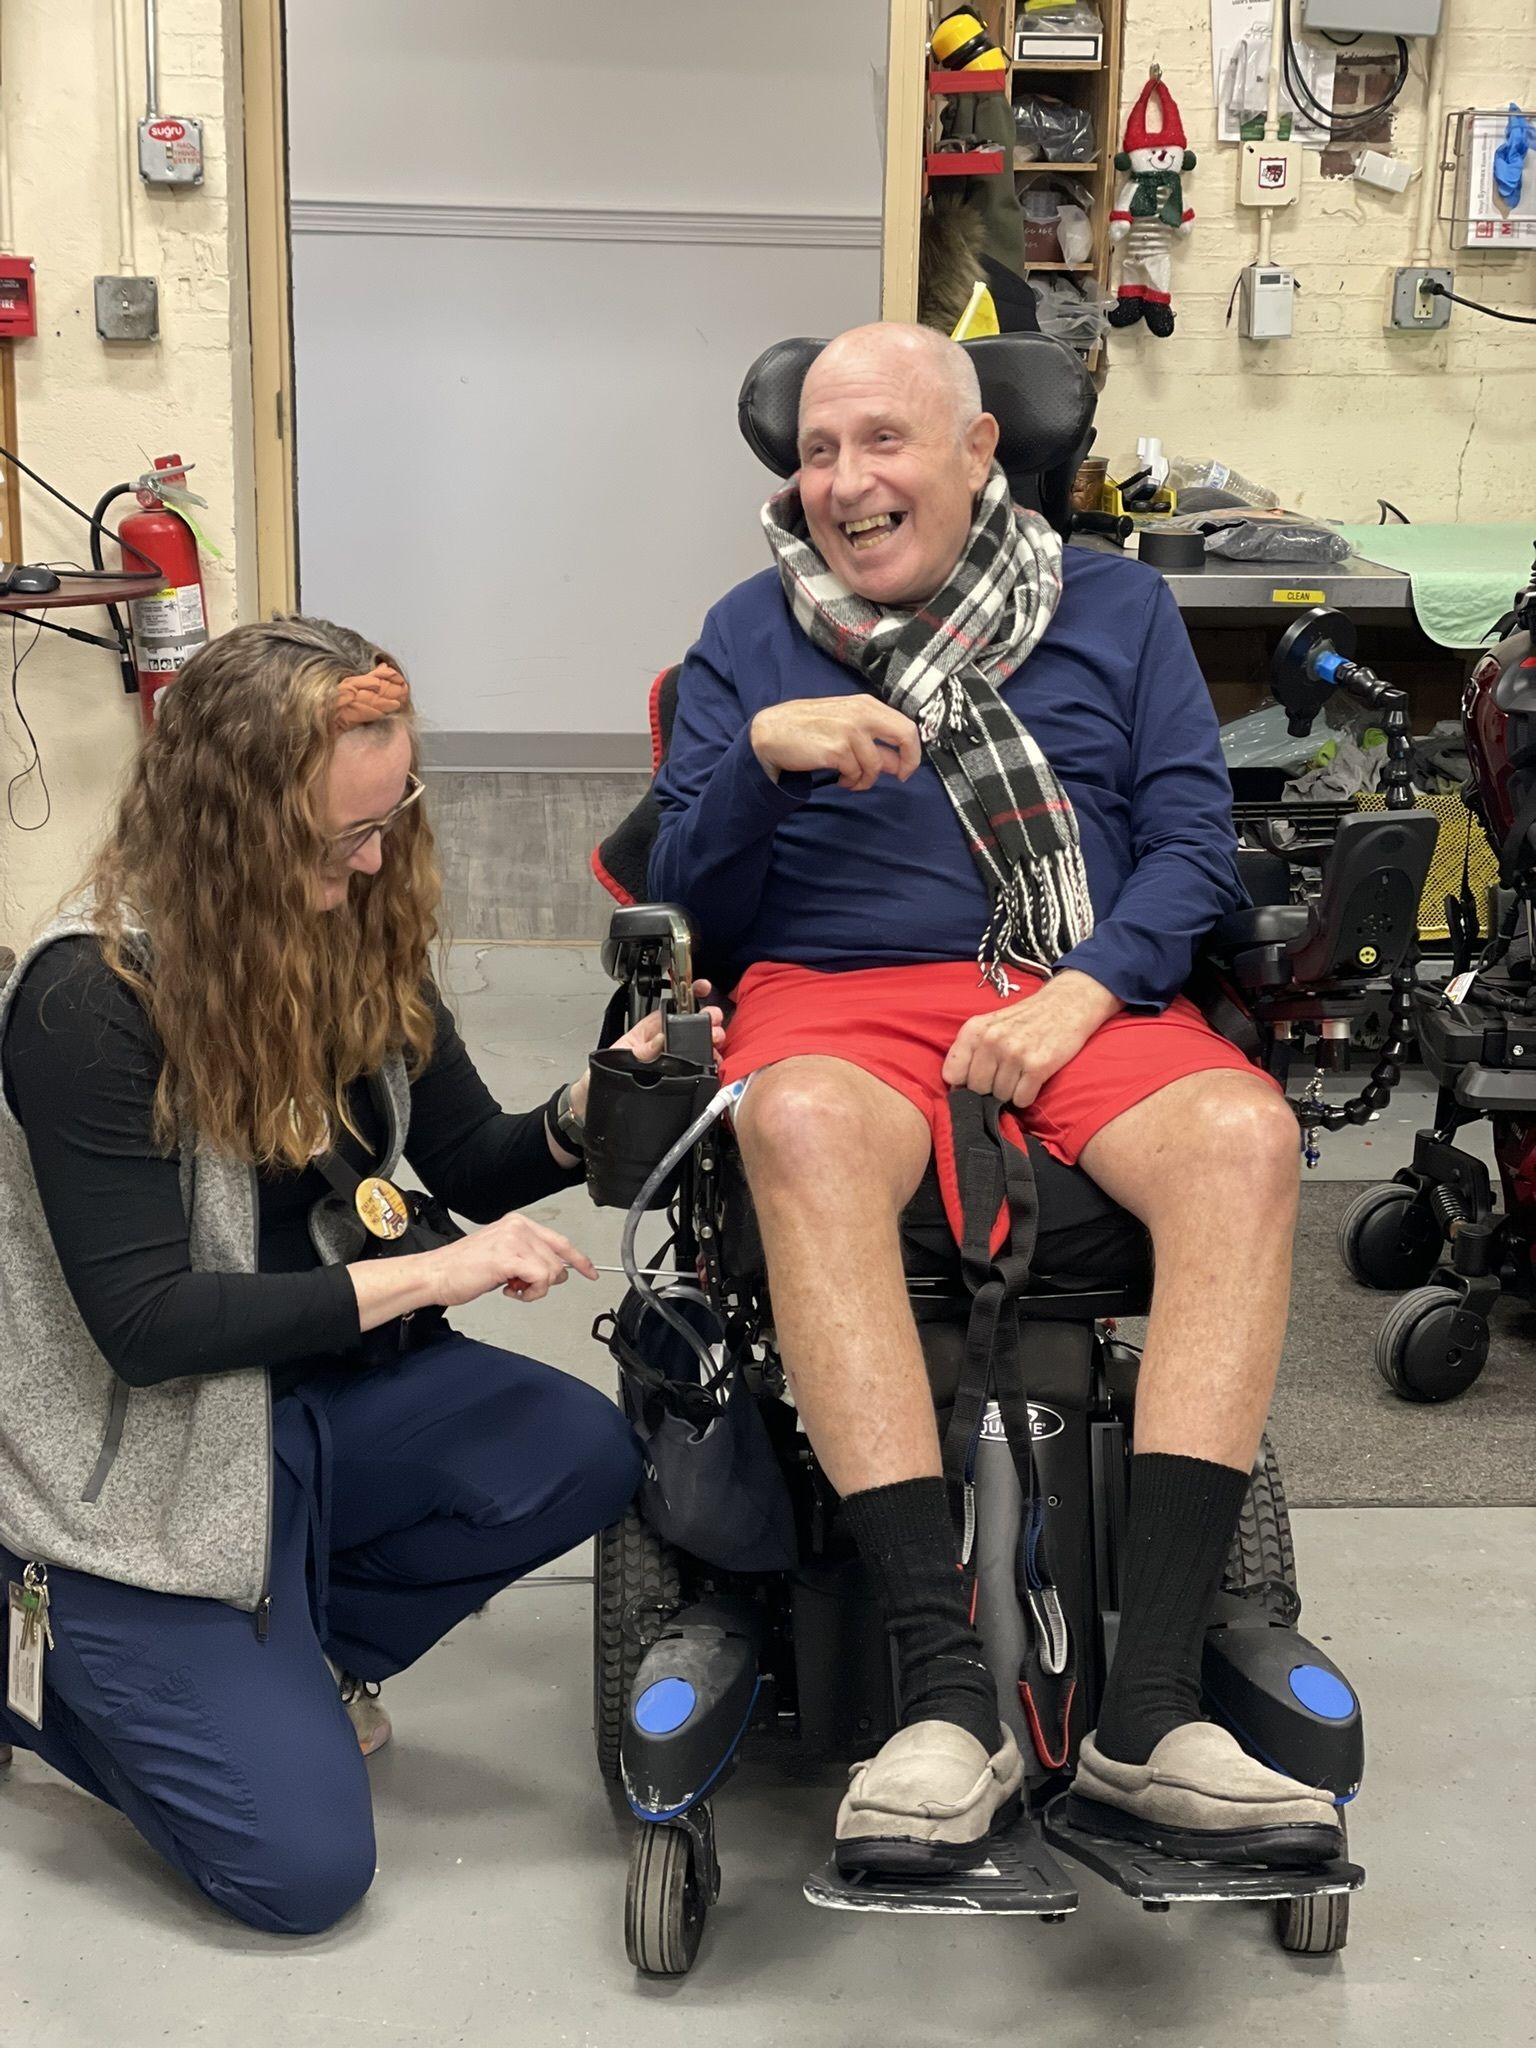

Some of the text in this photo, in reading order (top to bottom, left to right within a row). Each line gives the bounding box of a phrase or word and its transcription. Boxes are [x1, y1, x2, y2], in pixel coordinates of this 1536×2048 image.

[151, 126, 183, 138] sugru
[0, 299, 15, 310] IRE
[1287, 591, 1310, 600] CLEAN
